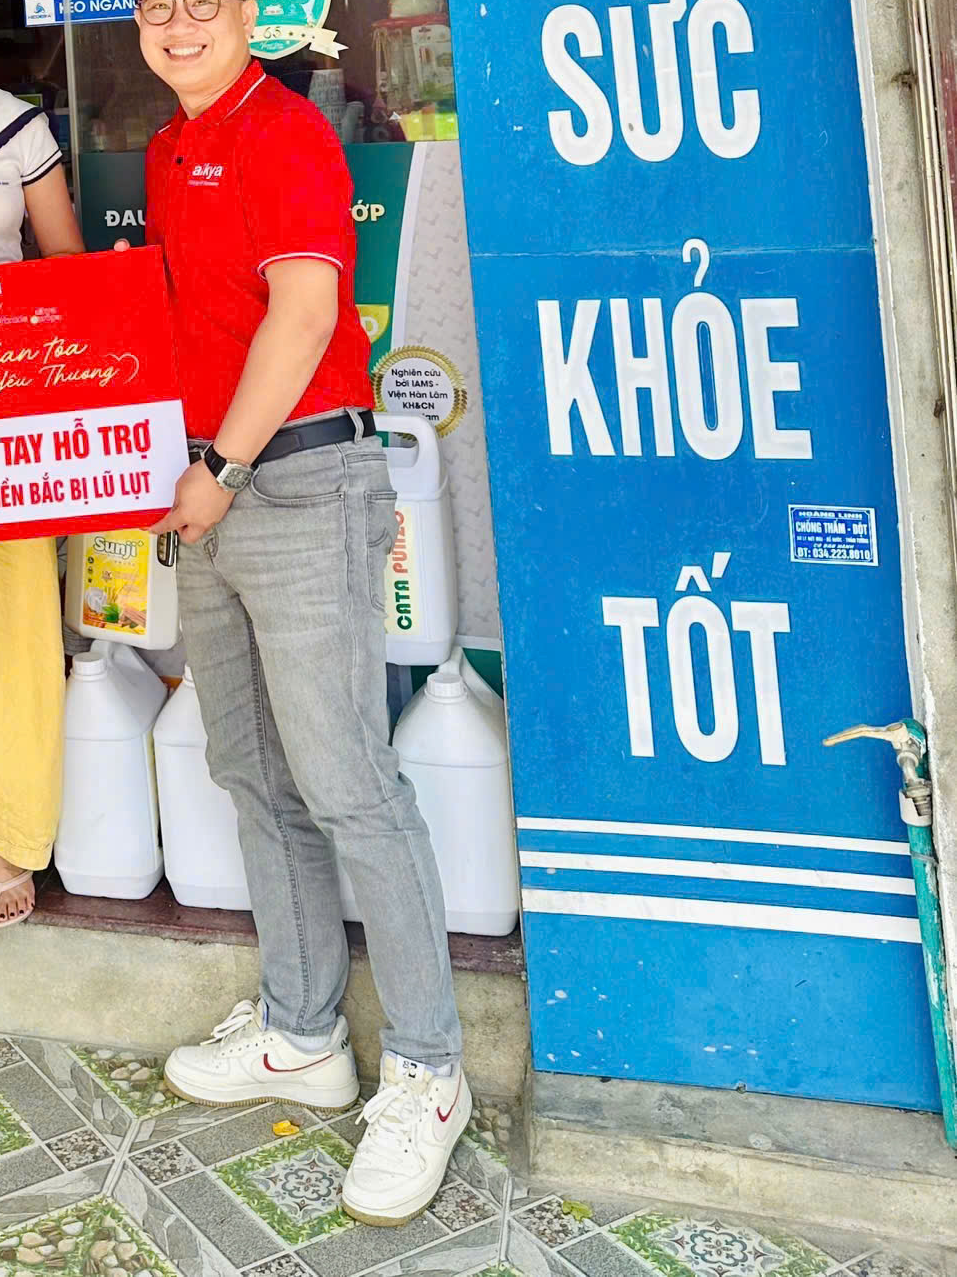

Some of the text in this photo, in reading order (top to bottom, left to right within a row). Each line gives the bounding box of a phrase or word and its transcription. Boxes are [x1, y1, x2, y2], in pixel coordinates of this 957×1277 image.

[351, 199, 385, 222] ỚP
[538, 238, 813, 461] KHỎE
[391, 368, 422, 378] Nghiên
[403, 402, 434, 410] KH&CN
[422, 413, 440, 421] am
[0, 433, 43, 467] TAY
[53, 418, 90, 461] HỖ
[97, 419, 151, 459] TRỢ
[29, 472, 65, 505] BẮC
[69, 477, 89, 505] BỊ
[93, 470, 115, 499] LŨ
[120, 471, 150, 500] LỤT
[795, 519, 822, 533] CHỐNG
[823, 519, 846, 534] THẤM
[93, 536, 138, 560] Sunji
[812, 548, 870, 560] 034.223.8010
[394, 580, 412, 631] CATA
[601, 551, 791, 766] TỐT
